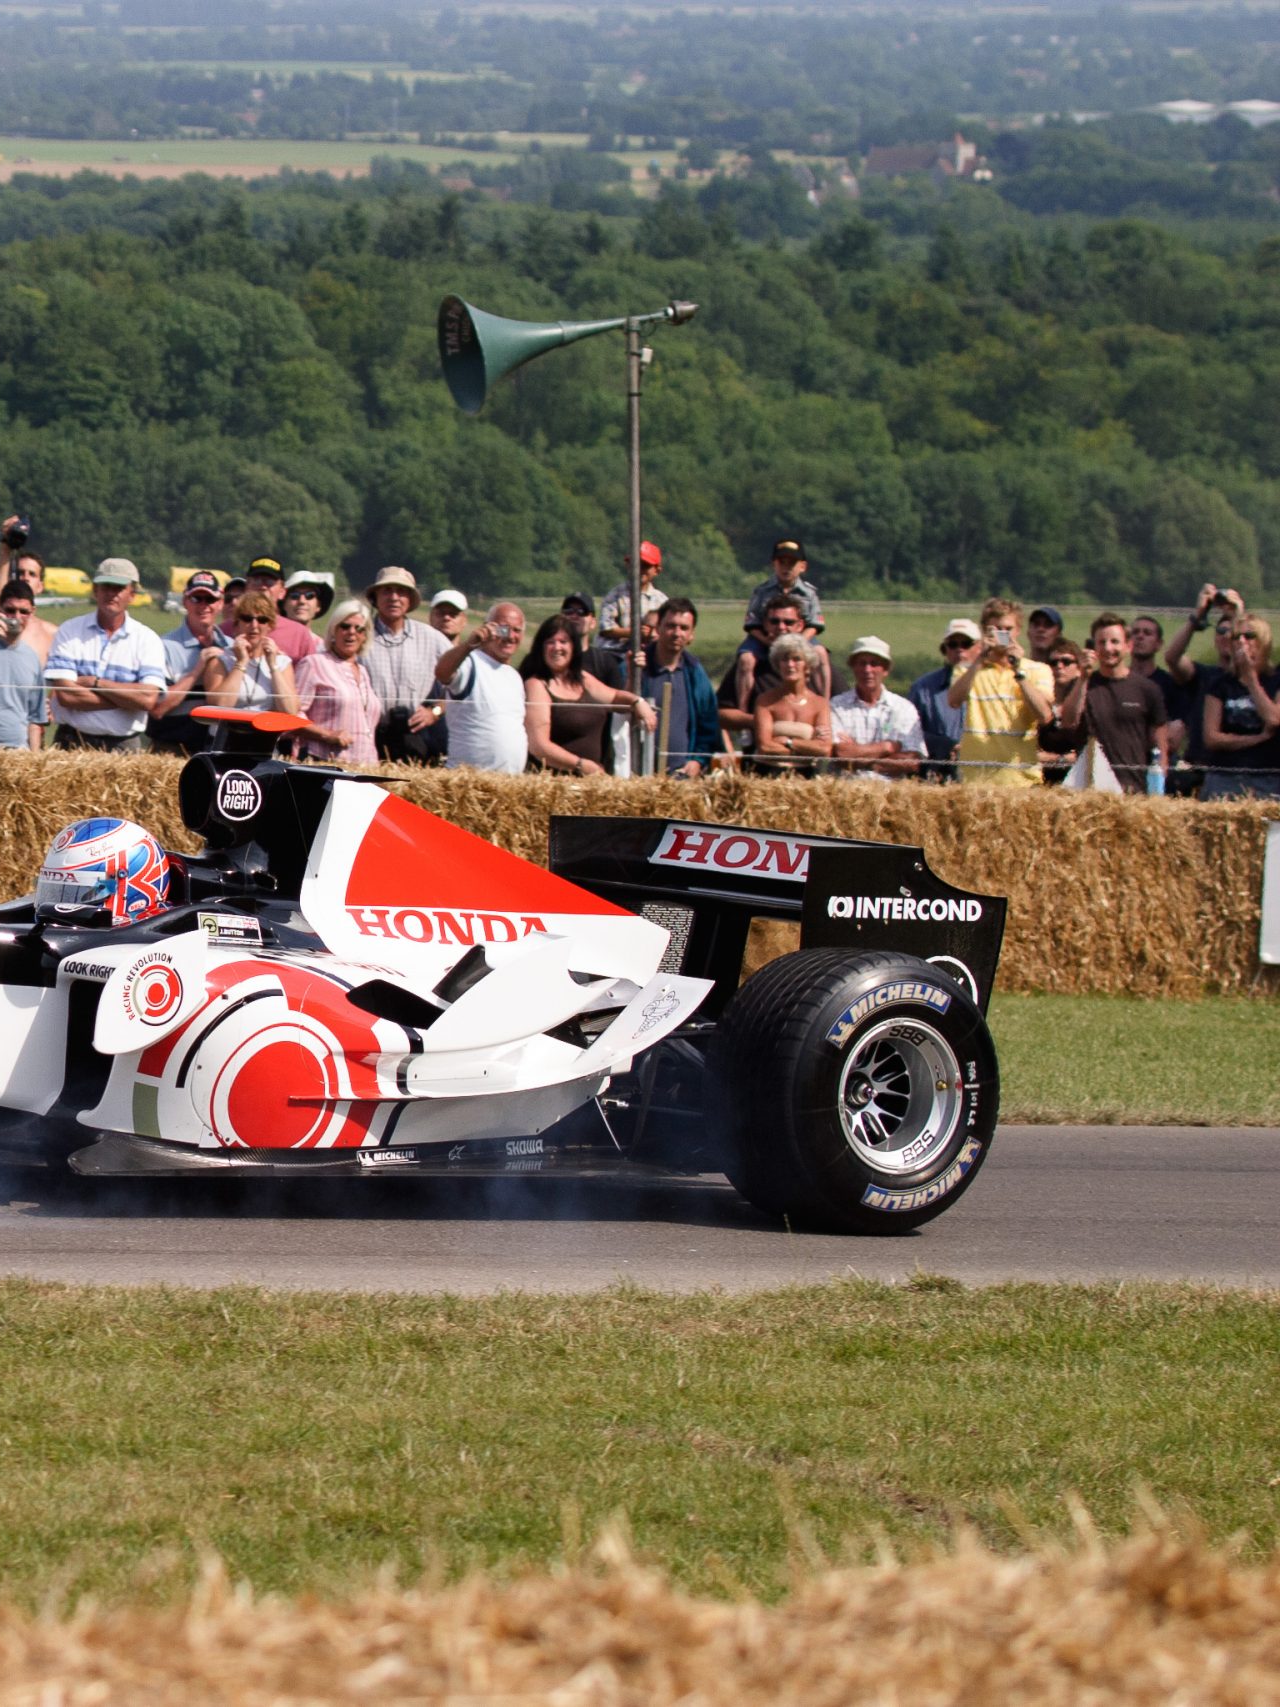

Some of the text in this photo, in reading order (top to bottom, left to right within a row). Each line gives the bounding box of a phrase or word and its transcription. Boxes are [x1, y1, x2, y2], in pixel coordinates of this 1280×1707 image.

[226, 779, 254, 795] LOOK
[223, 795, 255, 810] RIGHT
[660, 829, 809, 876] HON
[40, 870, 78, 883] NDA
[856, 897, 982, 921] INTERCOND
[64, 960, 89, 976] LOOK
[123, 952, 173, 1020] RACING REVOLUTION
[850, 983, 948, 1023] MICHELIN
[889, 1026, 927, 1046] BBS
[373, 1150, 415, 1162] MICHELIN
[505, 1138, 544, 1156] SHOWA
[902, 1129, 936, 1164] BBS
[867, 1165, 963, 1209] MICHELIN
